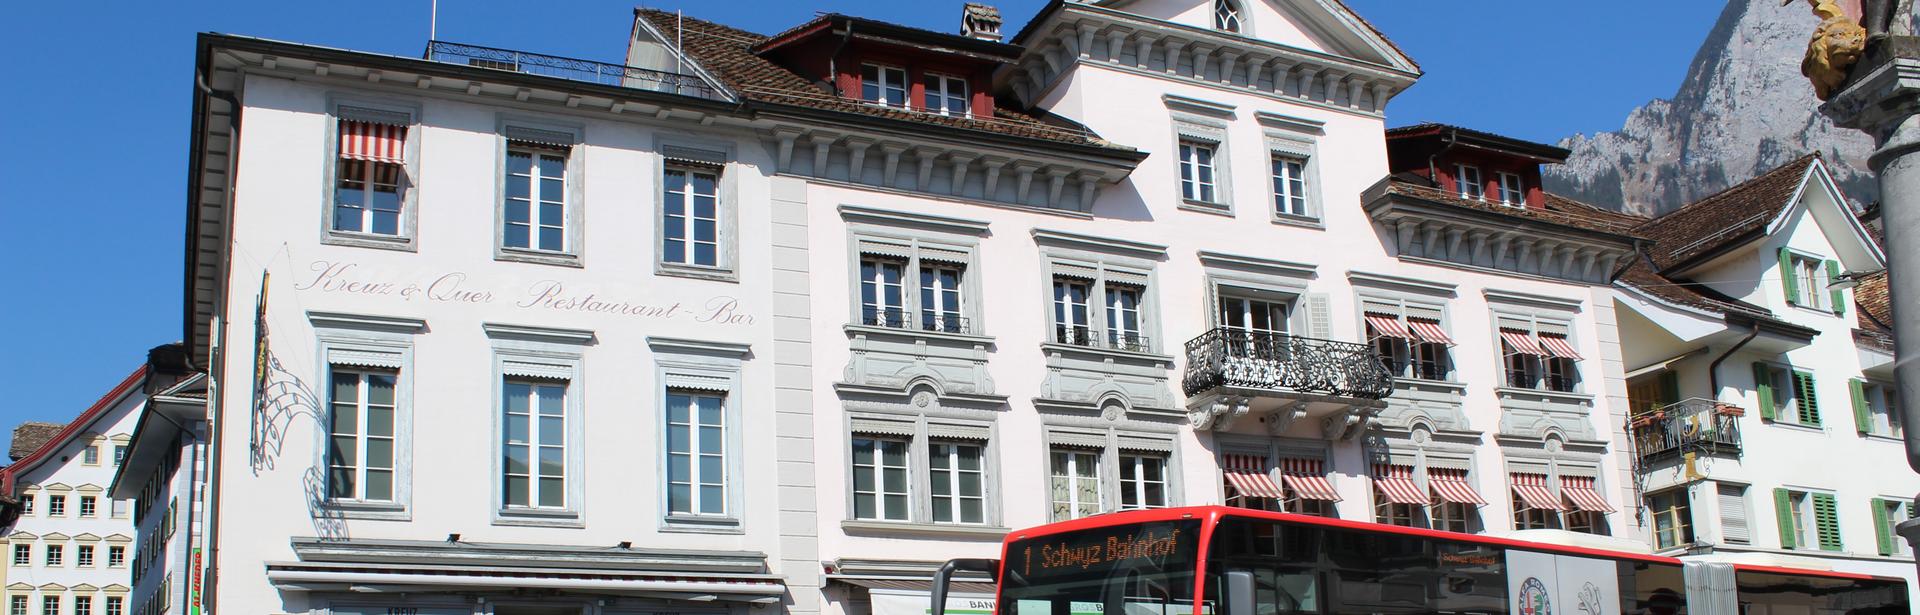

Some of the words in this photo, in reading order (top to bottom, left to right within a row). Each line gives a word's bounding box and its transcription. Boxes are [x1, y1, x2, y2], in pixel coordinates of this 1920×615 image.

[294, 260, 395, 295] Kreuz
[401, 283, 422, 301] &
[427, 272, 496, 304] Quer
[516, 279, 680, 319] Restaurant
[693, 295, 757, 326] Bar
[1024, 545, 1032, 576] 1
[1041, 541, 1102, 569] Schwyz
[1106, 528, 1182, 561] Bahnhof
